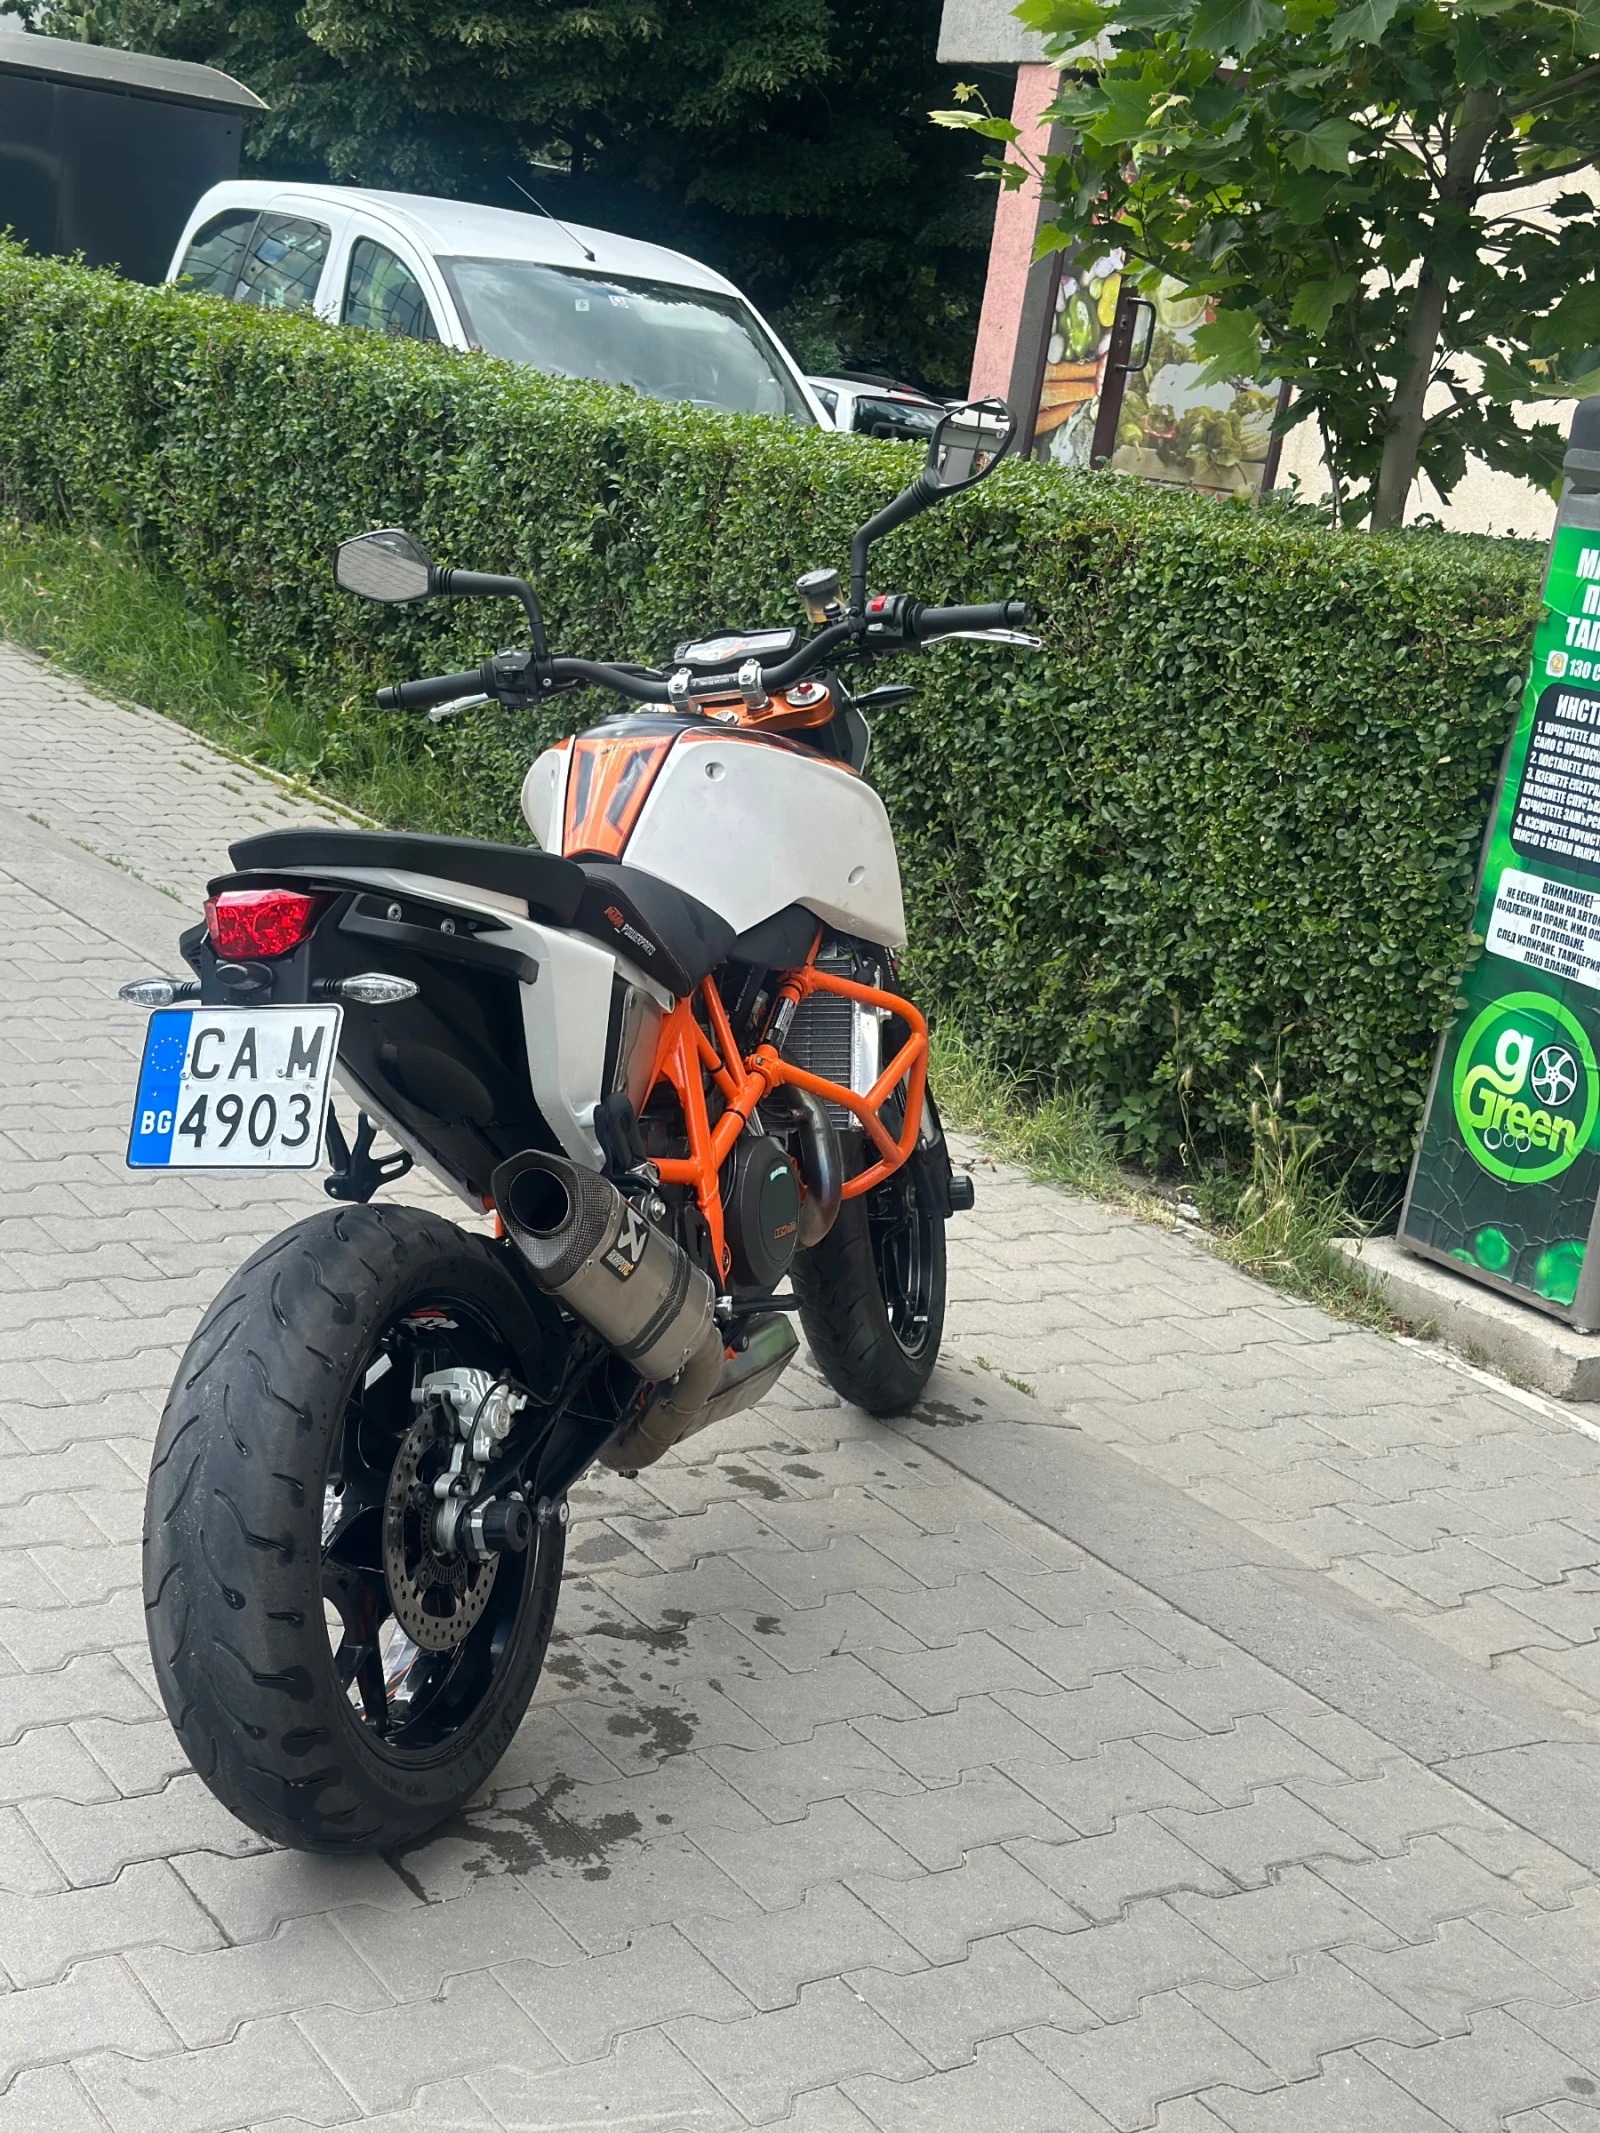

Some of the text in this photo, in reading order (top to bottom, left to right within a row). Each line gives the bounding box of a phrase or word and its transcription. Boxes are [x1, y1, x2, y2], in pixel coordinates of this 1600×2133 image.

[1582, 584, 1600, 616] П
[1569, 658, 1592, 679] 130
[1555, 694, 1600, 727] ИНСТ
[1529, 751, 1537, 764] 2.
[1567, 827, 1600, 848] ПОЧИСТ
[1506, 887, 1517, 899] НЕ
[1540, 897, 1565, 916] ТАВАН
[1565, 906, 1576, 918] НА
[1541, 882, 1594, 909] ВНИМАНИЕ!
[1496, 898, 1532, 918] ПОДЛЕЖИ
[1532, 909, 1542, 922] НА
[620, 923, 657, 957] POWERPARTS
[1496, 927, 1516, 945] СЛЕД
[1529, 923, 1541, 936] ОТ
[140, 1110, 172, 1135] BG
[178, 1094, 313, 1148] 4903
[1461, 1064, 1576, 1157] Green
